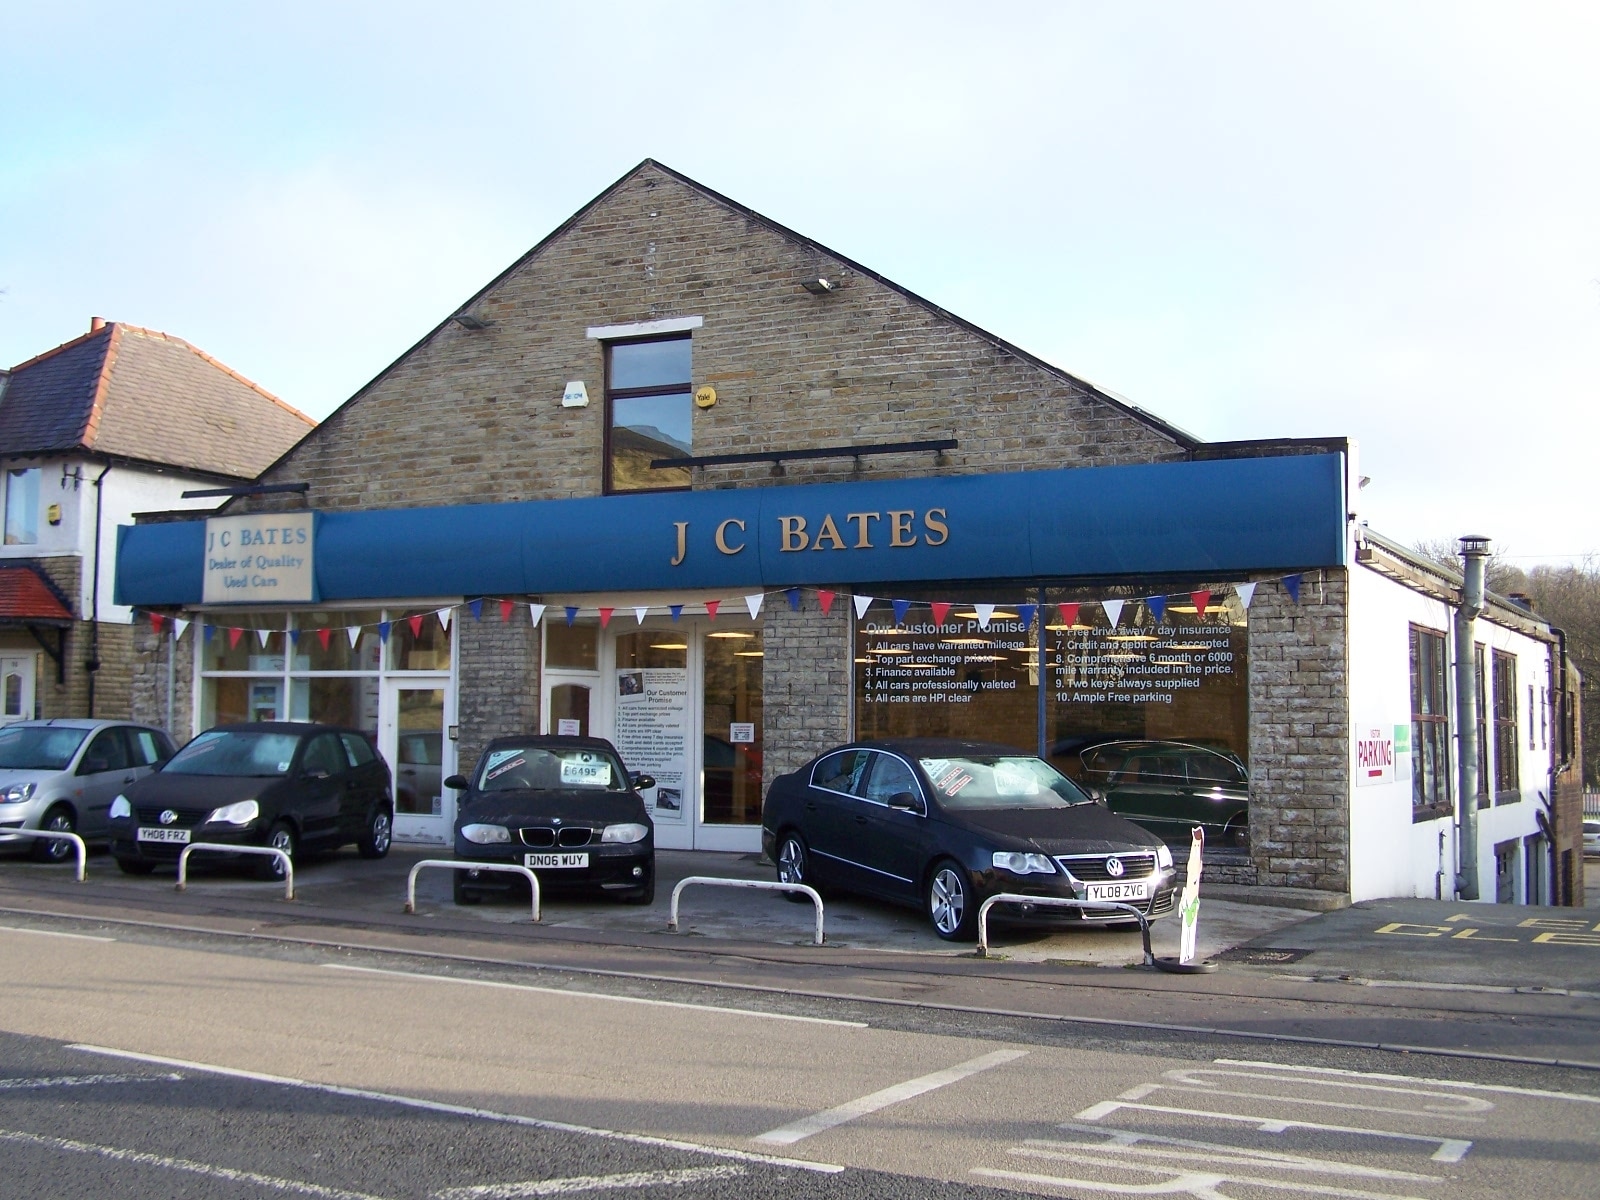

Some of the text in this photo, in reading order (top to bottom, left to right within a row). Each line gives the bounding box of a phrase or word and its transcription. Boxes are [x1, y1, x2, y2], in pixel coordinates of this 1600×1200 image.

[696, 393, 711, 401] Yale
[208, 528, 307, 552] J C BATES
[671, 507, 949, 567] J C BATES
[209, 555, 303, 570] Dealer of Quality
[224, 575, 278, 588] Used Cars
[866, 620, 1026, 636] Our Customer Promise
[1056, 628, 1065, 636] 6.
[1067, 628, 1089, 636] Free
[1092, 626, 1117, 636] drive
[1149, 626, 1155, 635] 7
[1158, 625, 1176, 636] day
[1180, 625, 1232, 634] insurance
[866, 640, 1025, 651] 1. All cars have warranted mileage
[1056, 638, 1229, 650] 7. Credit and debit cards accepted
[876, 654, 894, 665] Top
[896, 654, 914, 665] part
[916, 654, 962, 665] exchange
[1056, 654, 1065, 664] 8.
[1067, 654, 1146, 664] Comprehensive
[1149, 653, 1156, 662] 6
[1158, 652, 1191, 662] month
[1208, 652, 1233, 662] 6000
[866, 667, 955, 676] 3. Finance available
[1056, 666, 1076, 674] mile
[1126, 665, 1170, 674] included
[1172, 665, 1182, 674] in
[1185, 664, 1201, 673] the
[1205, 664, 1234, 676] price.
[865, 680, 873, 689] 4.
[876, 680, 888, 689] All
[912, 680, 978, 692] professionally
[981, 680, 1016, 689] valeted
[1056, 678, 1200, 690] 9. Two keys always supplied
[865, 694, 873, 702] 5.
[876, 694, 888, 702] All
[930, 694, 946, 702] HPI
[948, 694, 972, 702] clear
[1056, 692, 1172, 704] 10. Ample Free parking
[1358, 740, 1392, 767] PARKING
[563, 765, 597, 776] £6495
[168, 831, 186, 840] FRZ
[529, 855, 583, 866] DN06 WUY
[1093, 884, 1143, 898] YL08 ZVG
